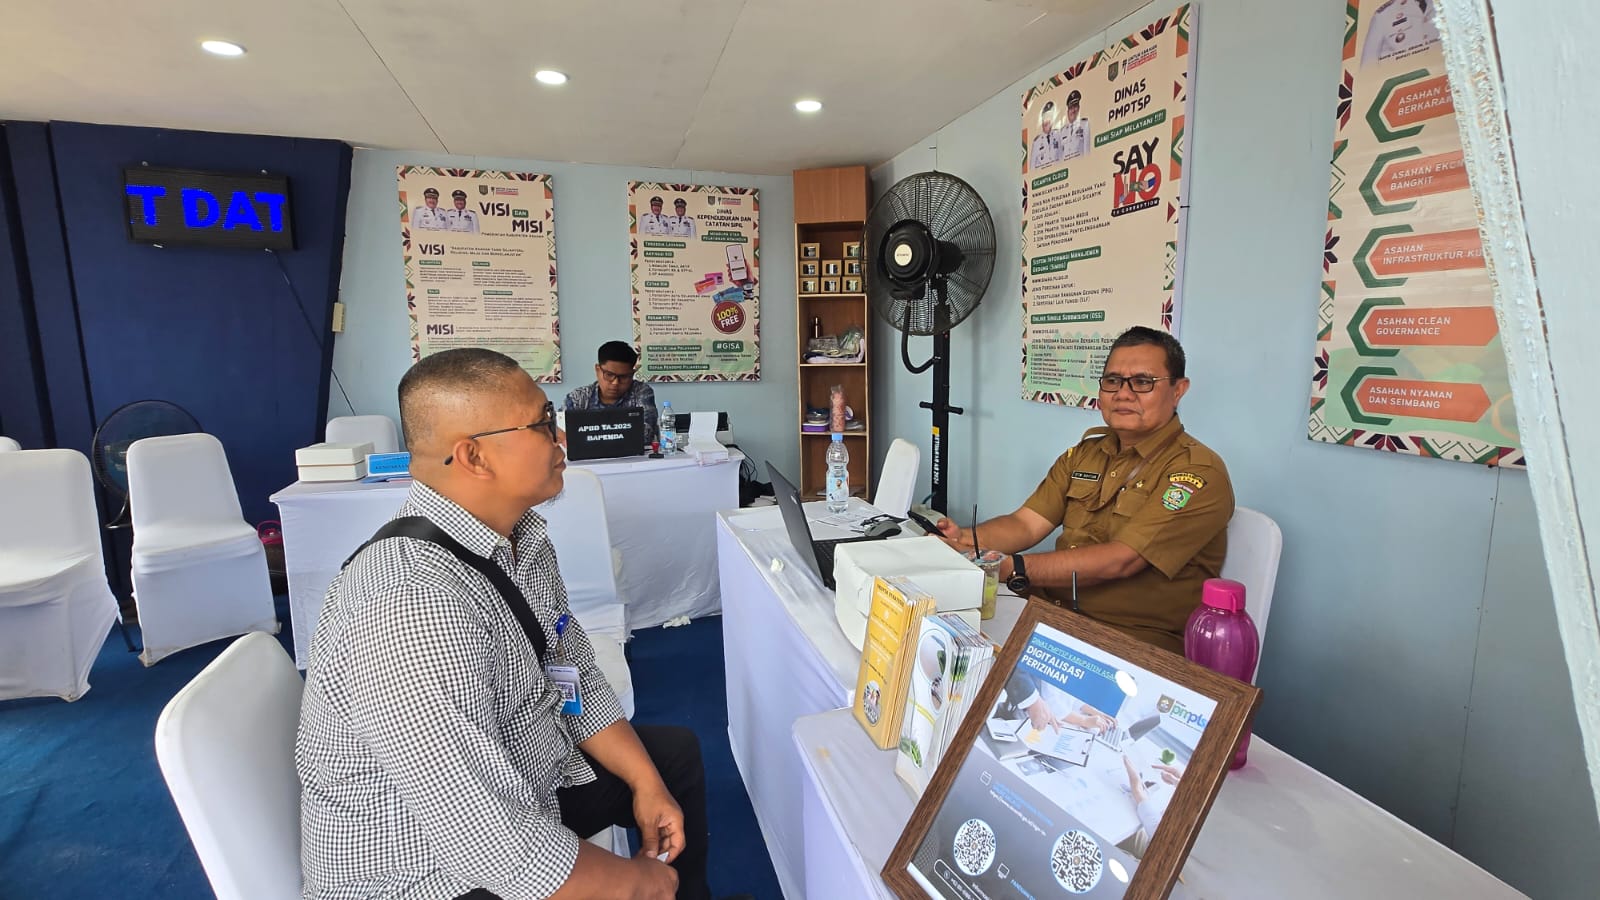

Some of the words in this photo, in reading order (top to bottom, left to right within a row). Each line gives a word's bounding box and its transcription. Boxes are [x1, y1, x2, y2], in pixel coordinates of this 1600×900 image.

[1114, 78, 1147, 103] DINAS
[1398, 87, 1441, 106] ASAHAN
[1108, 94, 1152, 123] PMPTSP
[1096, 134, 1110, 144] KAMI
[1110, 129, 1124, 141] SIAP
[1124, 118, 1154, 136] MELAYANI
[1113, 137, 1160, 175] SAY
[1391, 166, 1432, 180] ASAHAN
[1390, 176, 1434, 191] BANGKIT
[181, 188, 286, 232] DAT
[479, 202, 510, 216] VISI
[697, 214, 739, 222] KEPENDUDUKAN
[512, 219, 543, 233] MISI
[418, 243, 445, 255] VISI
[1384, 244, 1424, 255] ASAHAN
[1383, 250, 1464, 265] INFRASTRUKTUR
[717, 306, 739, 321] 100%
[720, 316, 740, 328] FREE
[1376, 317, 1415, 326] ASAHAN
[1418, 316, 1451, 325] CLEAN
[426, 324, 454, 335] MISI
[1376, 327, 1441, 336] GOVERNANCE
[716, 342, 740, 350] #GISA
[1370, 386, 1407, 396] ASAHAN
[1410, 389, 1453, 399] NYAMAN
[1369, 396, 1387, 405] DAN
[1390, 398, 1440, 409] SEIMBANG
[1021, 654, 1068, 684] PERIZINAN
[1026, 645, 1085, 680] DIGITALISASI
